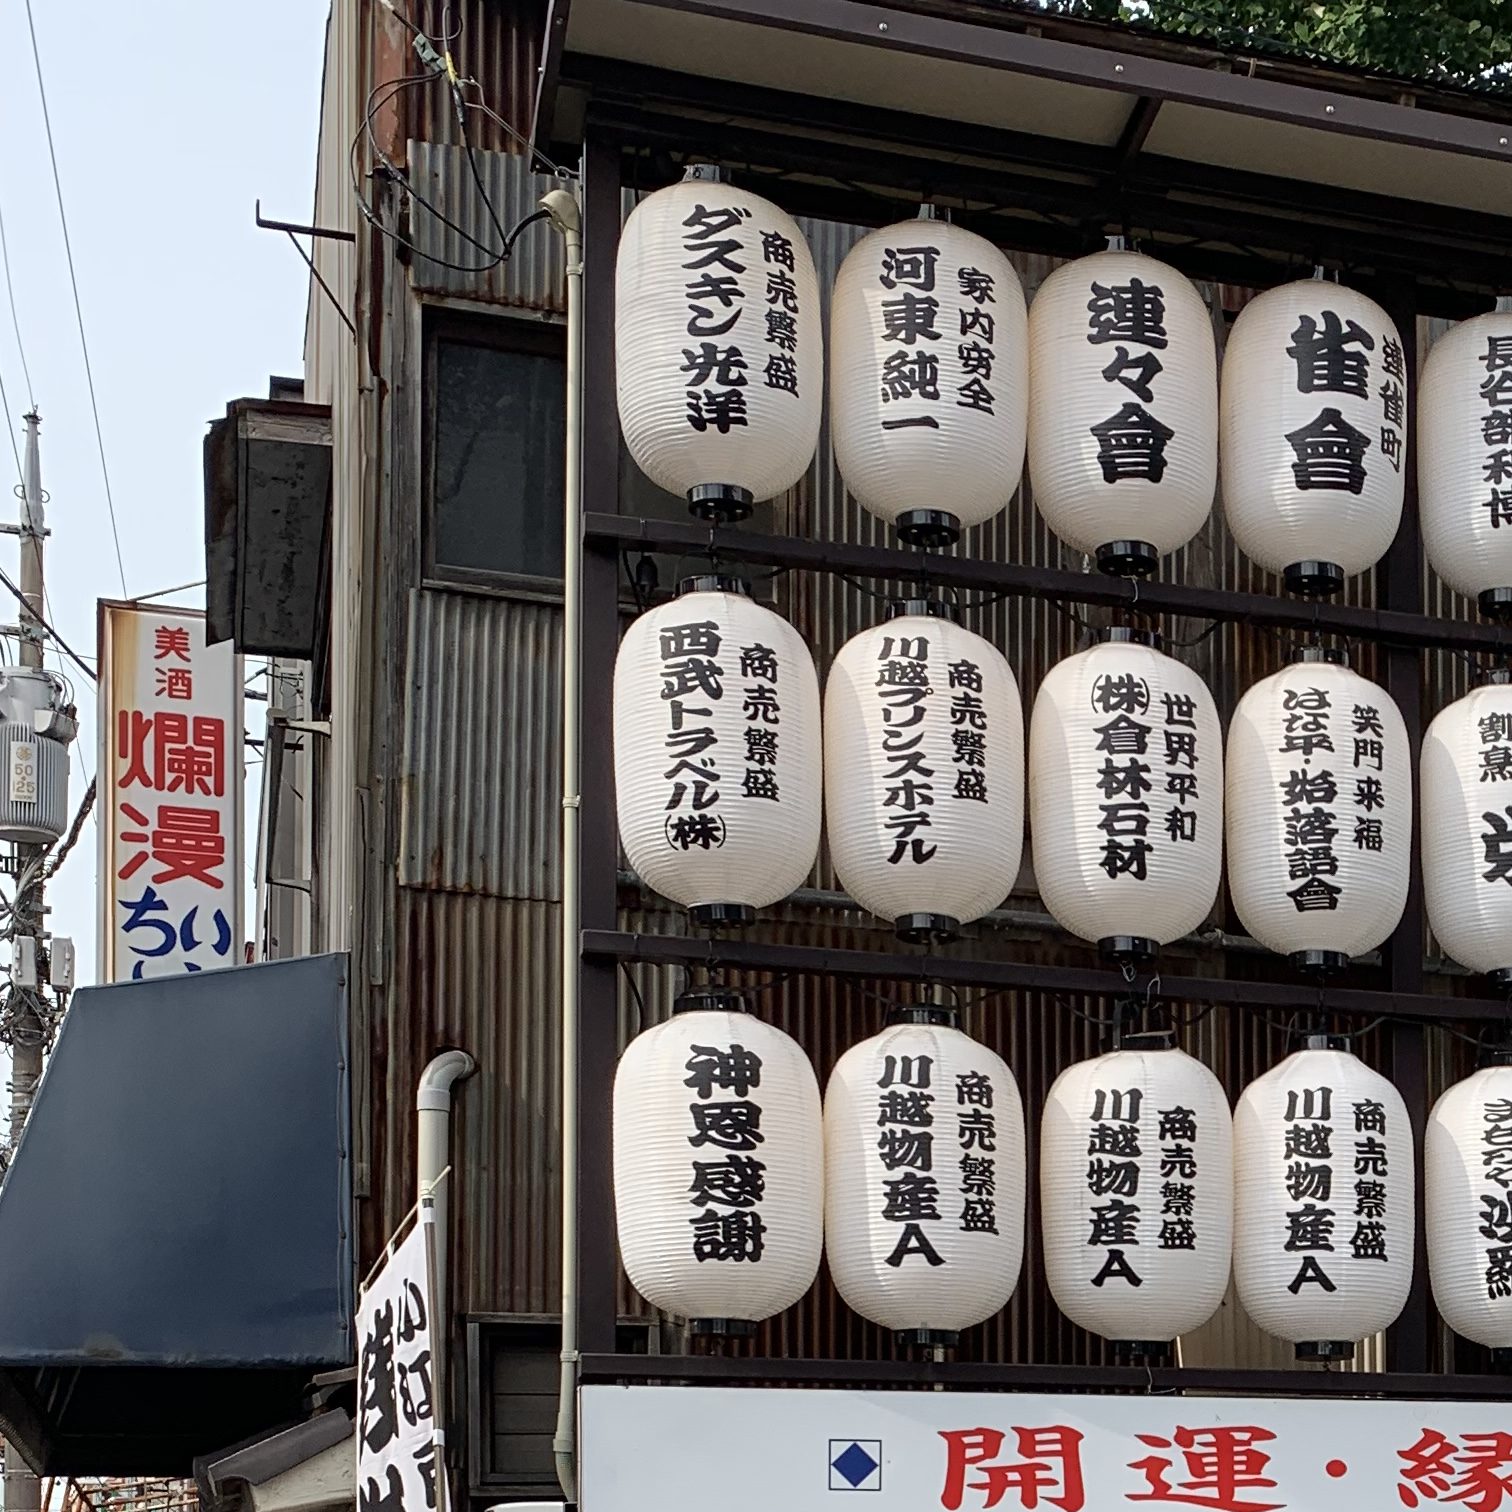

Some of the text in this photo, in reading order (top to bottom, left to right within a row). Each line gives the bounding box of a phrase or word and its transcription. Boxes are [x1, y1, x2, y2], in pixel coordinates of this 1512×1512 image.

[680, 204, 751, 434] ダスキン光洋
[759, 230, 800, 399] 商売繁盛
[879, 244, 943, 431] 河東純一
[956, 266, 997, 417] 家内安全
[153, 625, 192, 700] 美酒
[739, 642, 780, 803] 商売繁盛
[947, 658, 989, 804] 商売繁盛
[117, 709, 226, 890] 爛漫
[875, 636, 938, 865] 川越プリンスホテル
[1160, 692, 1199, 842] 世界平和
[1351, 704, 1384, 853] 笑門来福
[683, 1043, 768, 1264] 神恩感謝
[876, 1055, 946, 1268] 川越物産A
[955, 1070, 1000, 1236] 商売繁盛
[1086, 1087, 1144, 1288] 川越物産A
[1157, 1105, 1198, 1251] 商売繁盛
[1283, 1087, 1338, 1295] 川越物産A
[1349, 1098, 1389, 1263] 商売繁盛
